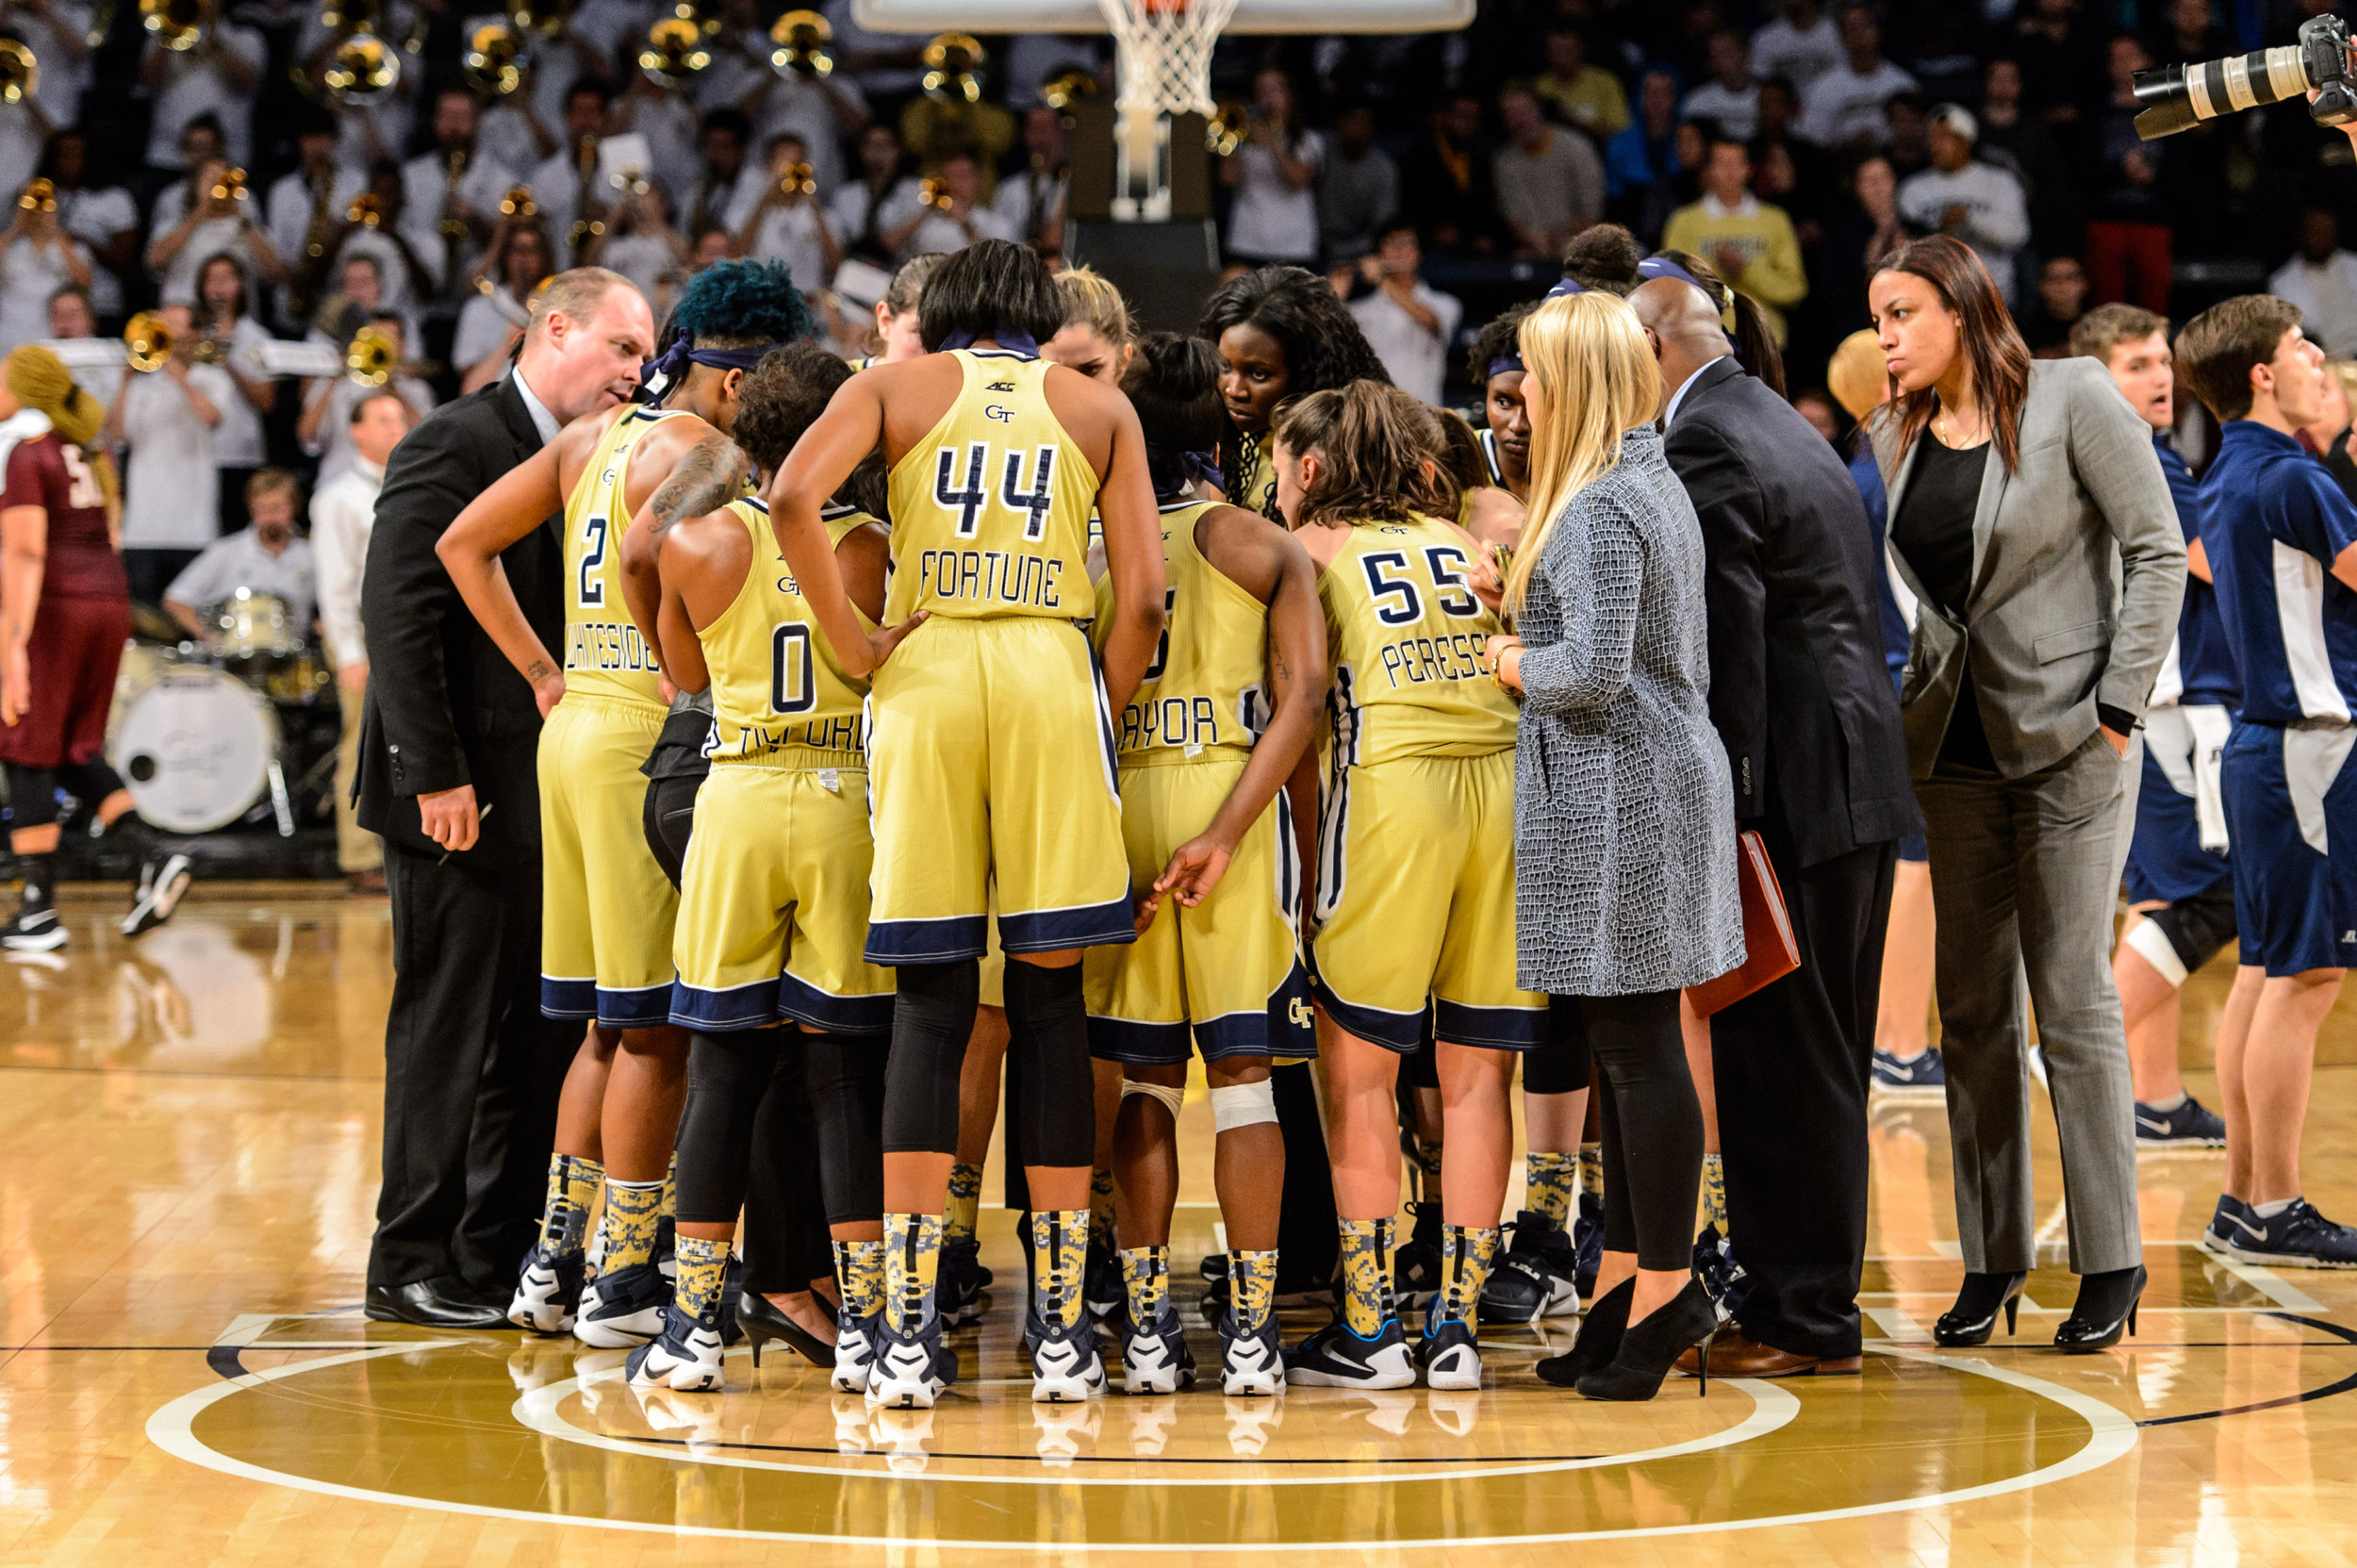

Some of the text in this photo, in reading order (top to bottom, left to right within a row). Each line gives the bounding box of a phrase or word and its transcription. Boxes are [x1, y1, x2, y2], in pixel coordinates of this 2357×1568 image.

[985, 381, 1016, 392] ACC
[985, 404, 1015, 423] GT
[932, 440, 1059, 542] 44
[578, 513, 608, 608] 2
[920, 550, 1063, 608] FORTUNE
[1357, 544, 1484, 629] 55
[770, 619, 817, 715] 0
[1115, 696, 1218, 752] AYOR
[1289, 997, 1314, 1029] GT
